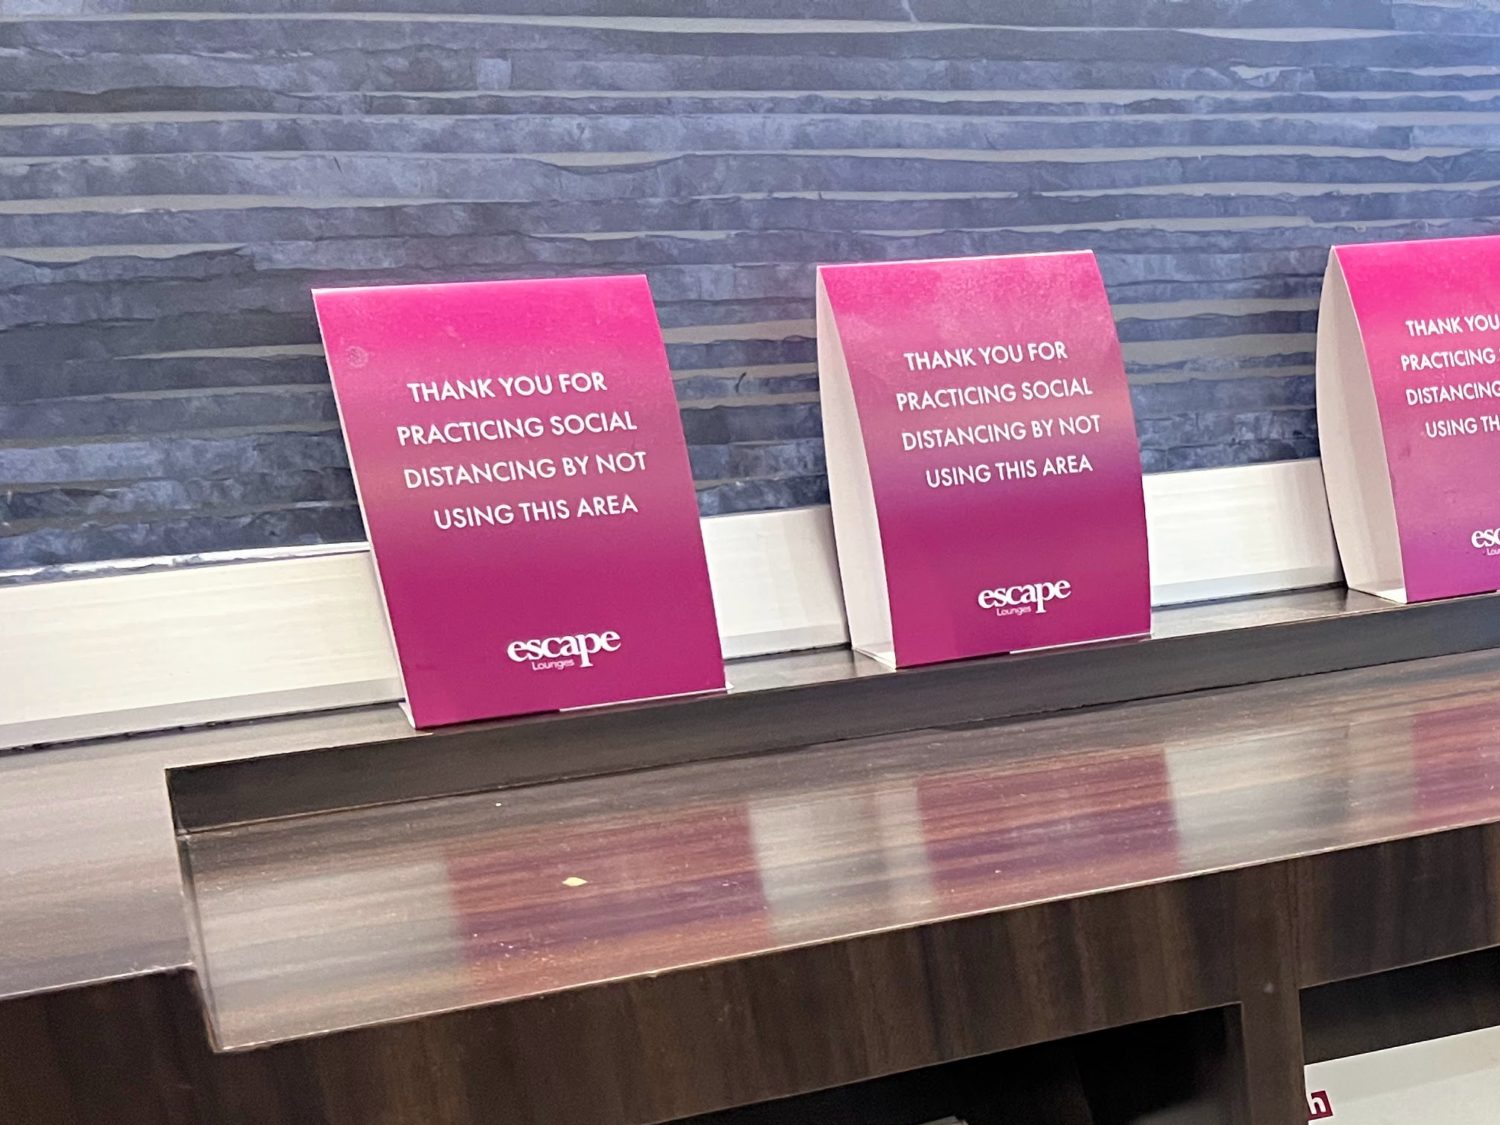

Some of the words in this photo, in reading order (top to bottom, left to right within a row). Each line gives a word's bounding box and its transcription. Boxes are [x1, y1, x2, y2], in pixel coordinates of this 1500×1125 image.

[1406, 316, 1463, 336] THANK
[1464, 314, 1499, 331] YOU
[904, 348, 976, 371] THANK
[979, 344, 1023, 364] YOU
[1027, 341, 1068, 361] FOR
[1401, 348, 1496, 371] PRACTICING
[407, 378, 496, 403] THANK
[498, 375, 553, 397] YOU
[558, 372, 607, 393] FOR
[896, 384, 1016, 411] PRACTICING
[1022, 377, 1093, 400] SOCIAL
[396, 417, 544, 446] PRACTICING
[550, 411, 637, 436] SOCIAL
[902, 422, 1026, 451] DISTANCING
[1031, 419, 1053, 438] BY
[1058, 415, 1100, 435] NOT
[1425, 418, 1477, 438] USING
[404, 458, 556, 488] DISTANCING
[562, 456, 588, 477] BY
[596, 452, 646, 473] NOT
[926, 464, 991, 488] USING
[995, 459, 1037, 480] THIS
[1043, 454, 1093, 476] AREA
[434, 504, 514, 529] USING
[519, 500, 570, 522] THIS
[577, 494, 638, 518] AREA
[978, 580, 1071, 613] escape
[996, 606, 1031, 616] Lounges
[507, 630, 621, 668] escape
[531, 659, 575, 670] Lounges
